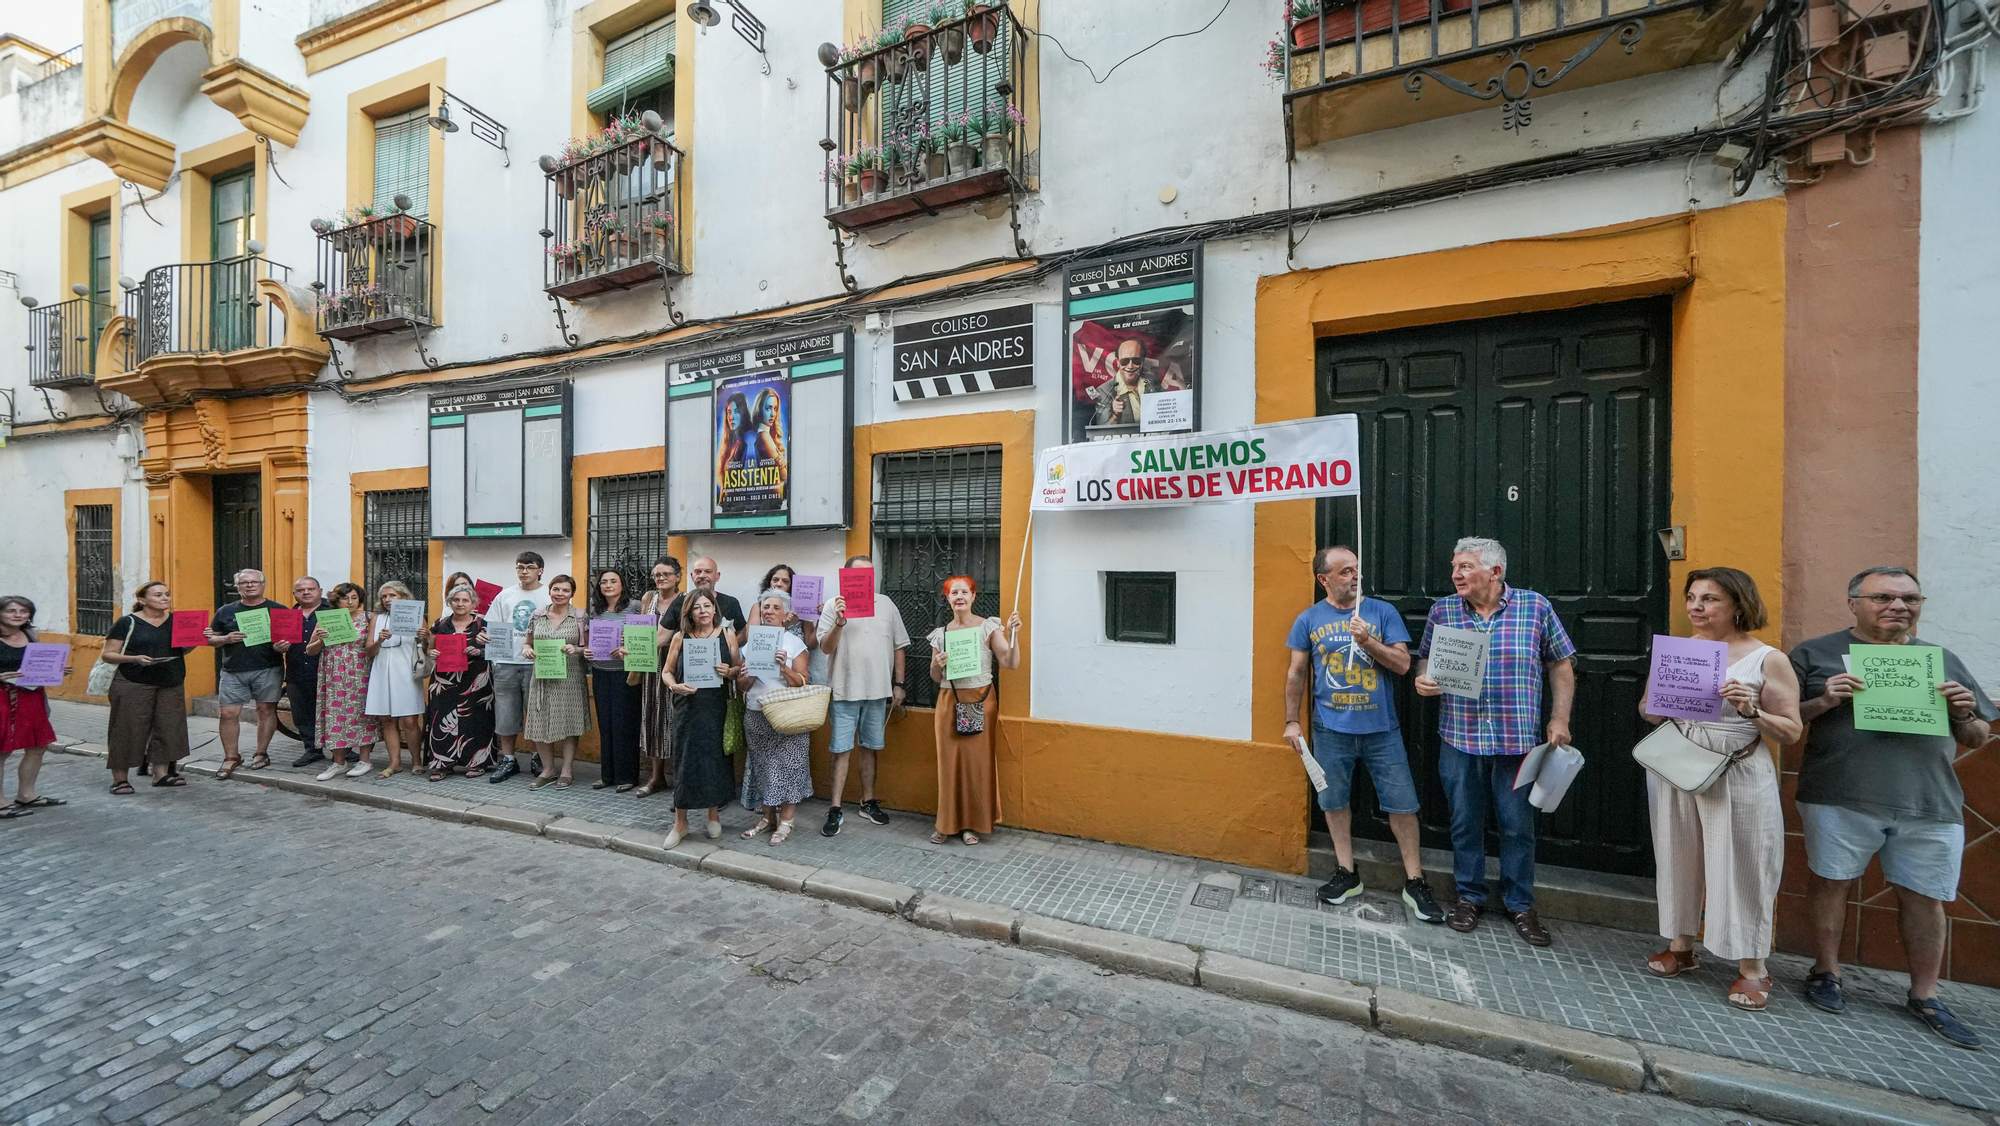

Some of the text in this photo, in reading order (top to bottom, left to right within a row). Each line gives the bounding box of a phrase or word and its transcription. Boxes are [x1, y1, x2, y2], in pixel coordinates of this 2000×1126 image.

[1070, 252, 1188, 283] COLISEO SAN ANDRES
[932, 314, 988, 335] COLISEO
[702, 357, 715, 368] SAN
[718, 353, 742, 364] ANDRES
[756, 348, 777, 358] COLISEO
[780, 342, 796, 354] SAN
[800, 336, 831, 350] ANDRES
[900, 336, 1024, 372] SAN ANDRES
[1077, 343, 1187, 390] VOA
[466, 393, 487, 402] ANDRES
[518, 389, 530, 397] SAN
[532, 386, 555, 395] ANDRES
[1131, 438, 1266, 473] SALVEMOS
[748, 458, 755, 467] LA
[724, 466, 780, 488] ASISTENTA
[1077, 459, 1352, 502] LOS CINES DE VERANO
[1508, 485, 1519, 501] 6
[1437, 641, 1472, 650] MENTIRAS
[1448, 638, 1474, 646] QUEREMOS
[1436, 648, 1468, 656] QUEREMOS
[1434, 663, 1469, 672] VERANO
[1863, 657, 1921, 668] CORDOBA
[1658, 667, 1688, 675] CINES
[1431, 674, 1461, 684] SALVEMOS
[1658, 674, 1700, 684] VERANO
[1928, 681, 1936, 705] ALCALDE
[1654, 695, 1701, 706] SALVEMOS
[1685, 706, 1712, 714] VERANO
[1864, 707, 1914, 715] SALVEMOS
